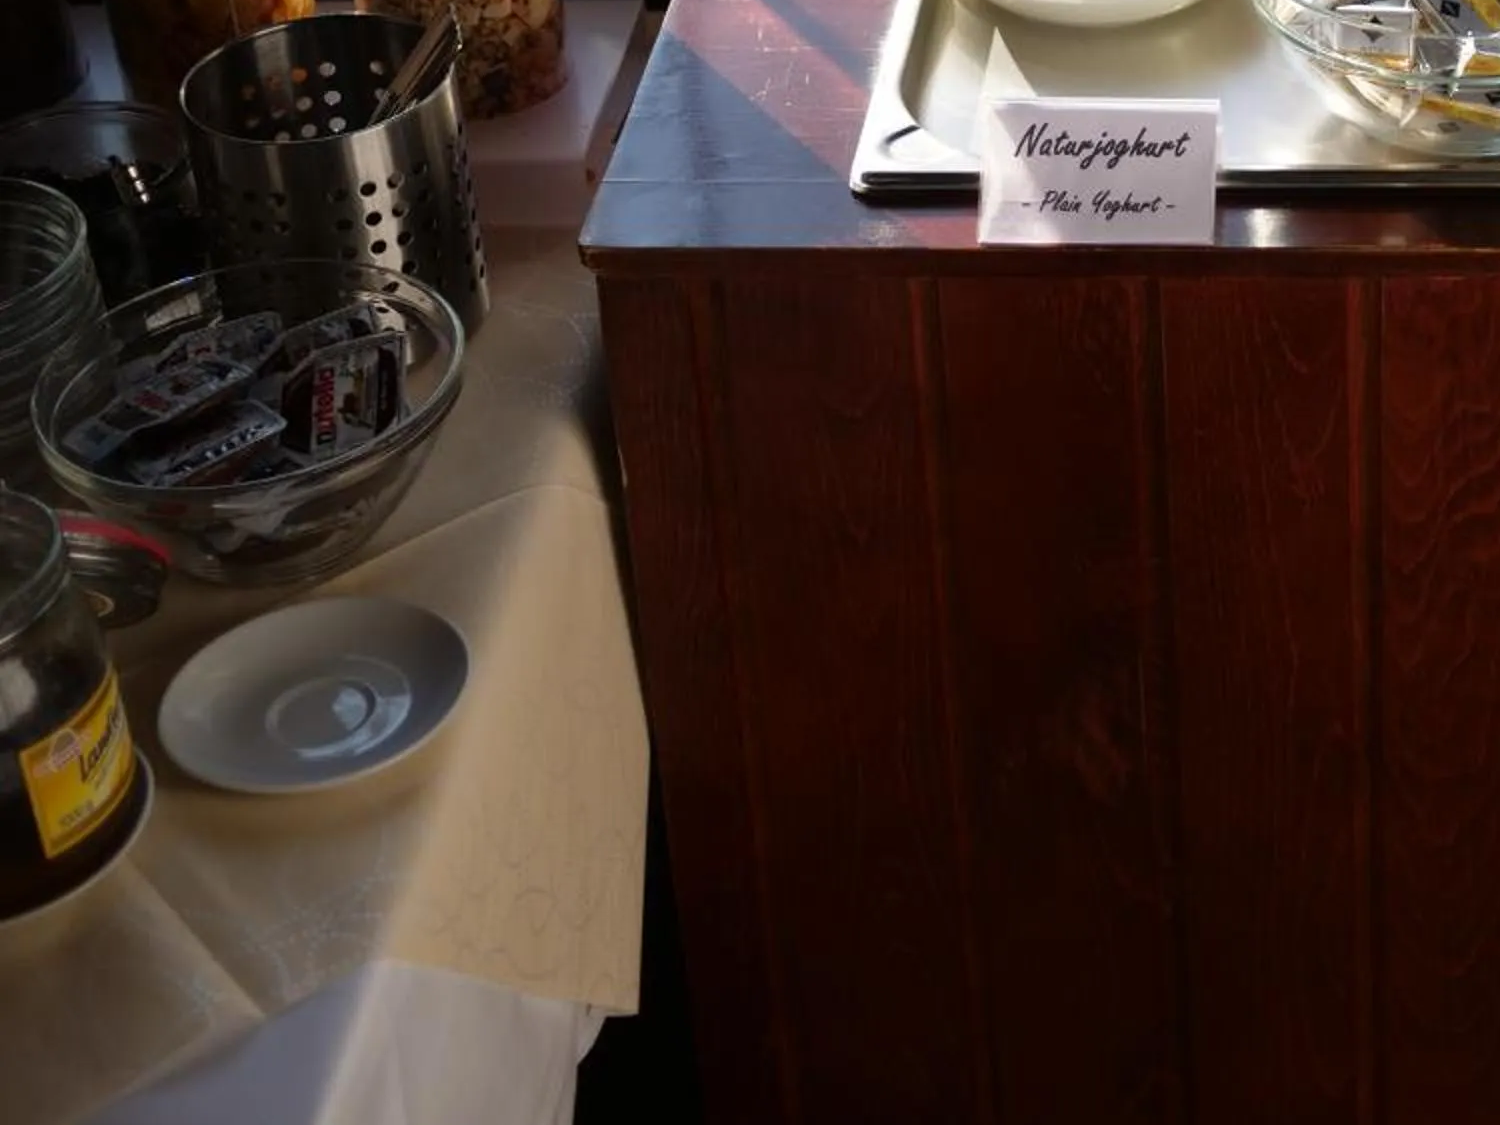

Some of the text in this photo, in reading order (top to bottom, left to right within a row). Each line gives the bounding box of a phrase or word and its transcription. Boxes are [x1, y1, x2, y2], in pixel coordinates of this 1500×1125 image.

[1014, 122, 1191, 170] Naturjoghurt
[1039, 190, 1082, 214] Plain
[1091, 189, 1162, 221] Yoghurt
[311, 367, 337, 445] nutella
